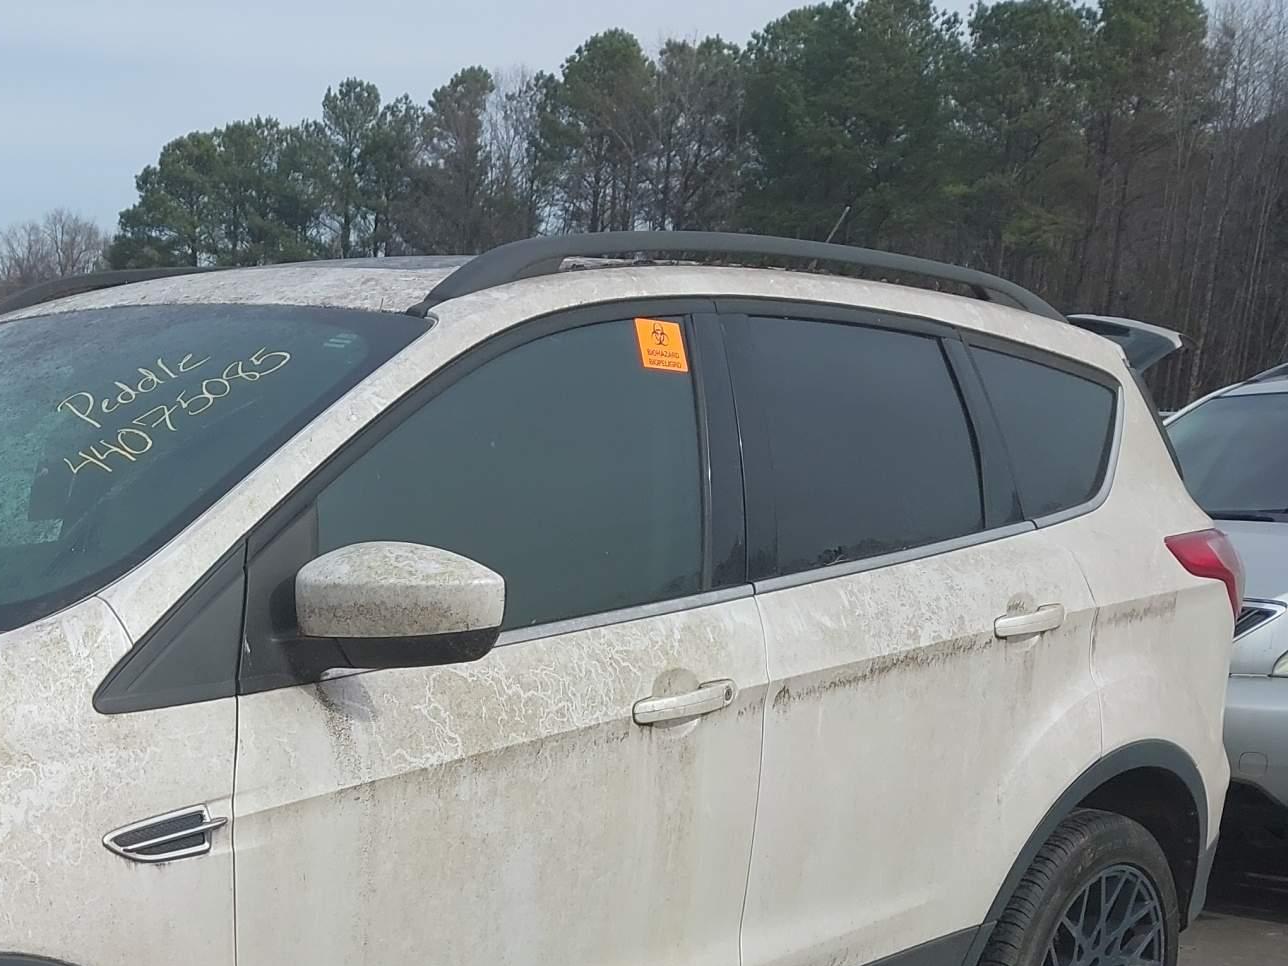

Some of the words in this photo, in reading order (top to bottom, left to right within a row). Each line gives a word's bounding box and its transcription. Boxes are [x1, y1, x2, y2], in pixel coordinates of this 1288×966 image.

[57, 352, 211, 429] Peddle
[647, 348, 680, 359] BIOHAZARD
[64, 347, 291, 475] 44075085
